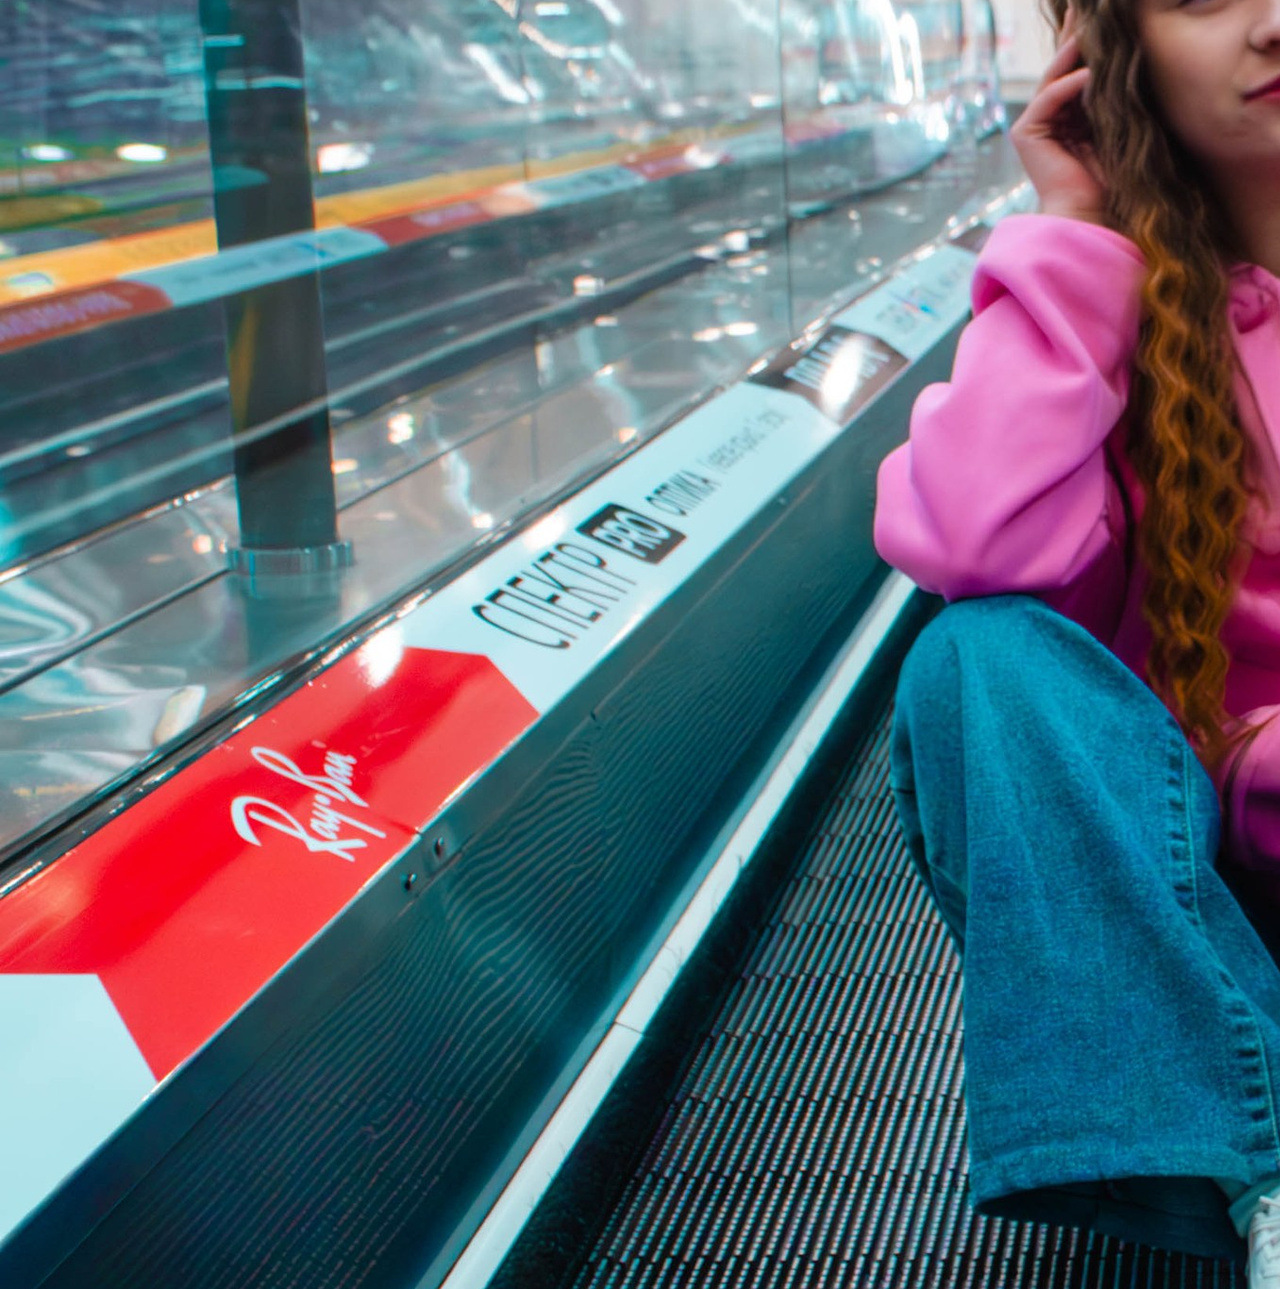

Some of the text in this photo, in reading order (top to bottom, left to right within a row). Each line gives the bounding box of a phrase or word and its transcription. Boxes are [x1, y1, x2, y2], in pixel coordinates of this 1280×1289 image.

[472, 470, 721, 649] СПЕКТР PRO ОПТИКА
